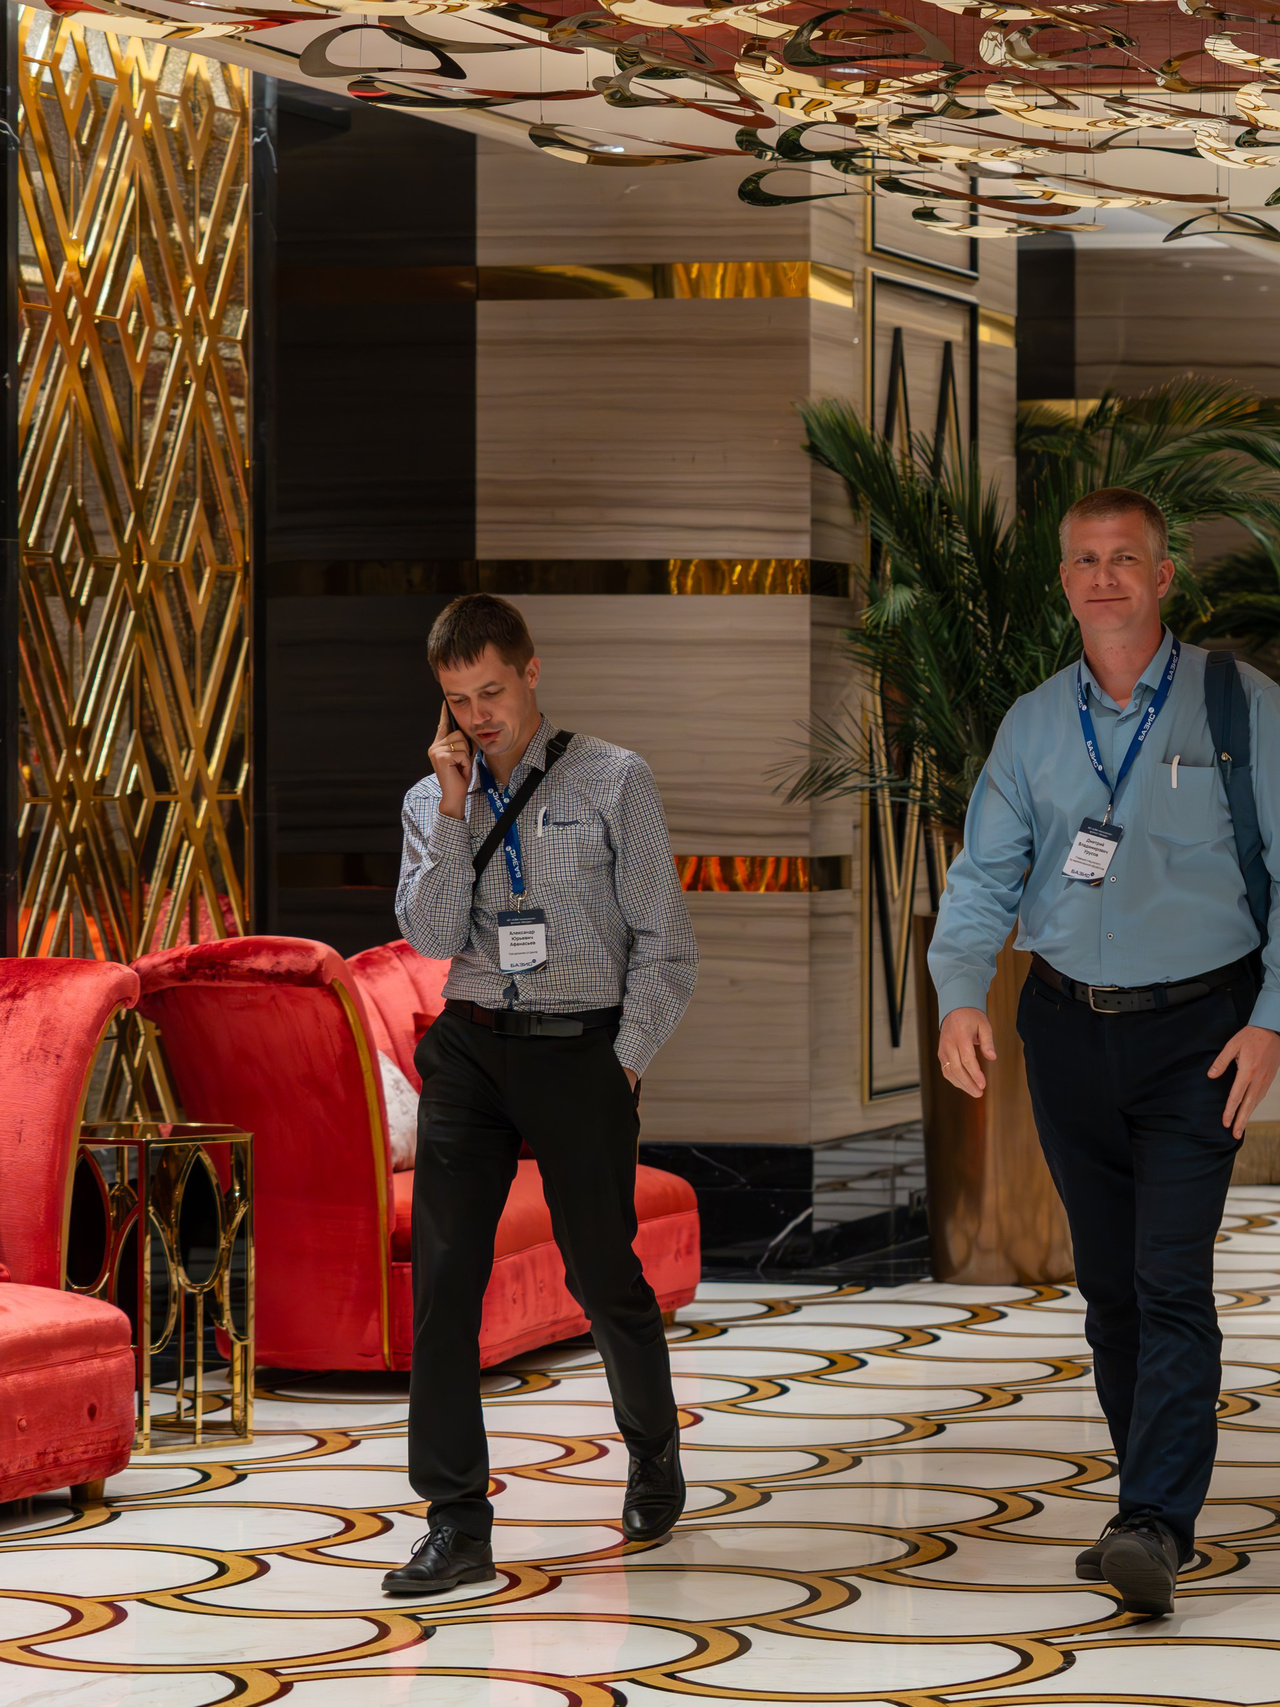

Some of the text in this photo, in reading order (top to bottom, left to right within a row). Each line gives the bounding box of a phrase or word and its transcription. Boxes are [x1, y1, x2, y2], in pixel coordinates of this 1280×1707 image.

[1167, 655, 1179, 681] БАЗИС
[1138, 713, 1156, 741] БАЗИС
[1086, 740, 1099, 768] БАЗИС
[492, 791, 505, 813] АЗИС
[509, 849, 522, 879] БАЗИС
[1071, 868, 1090, 878] БАЗИС
